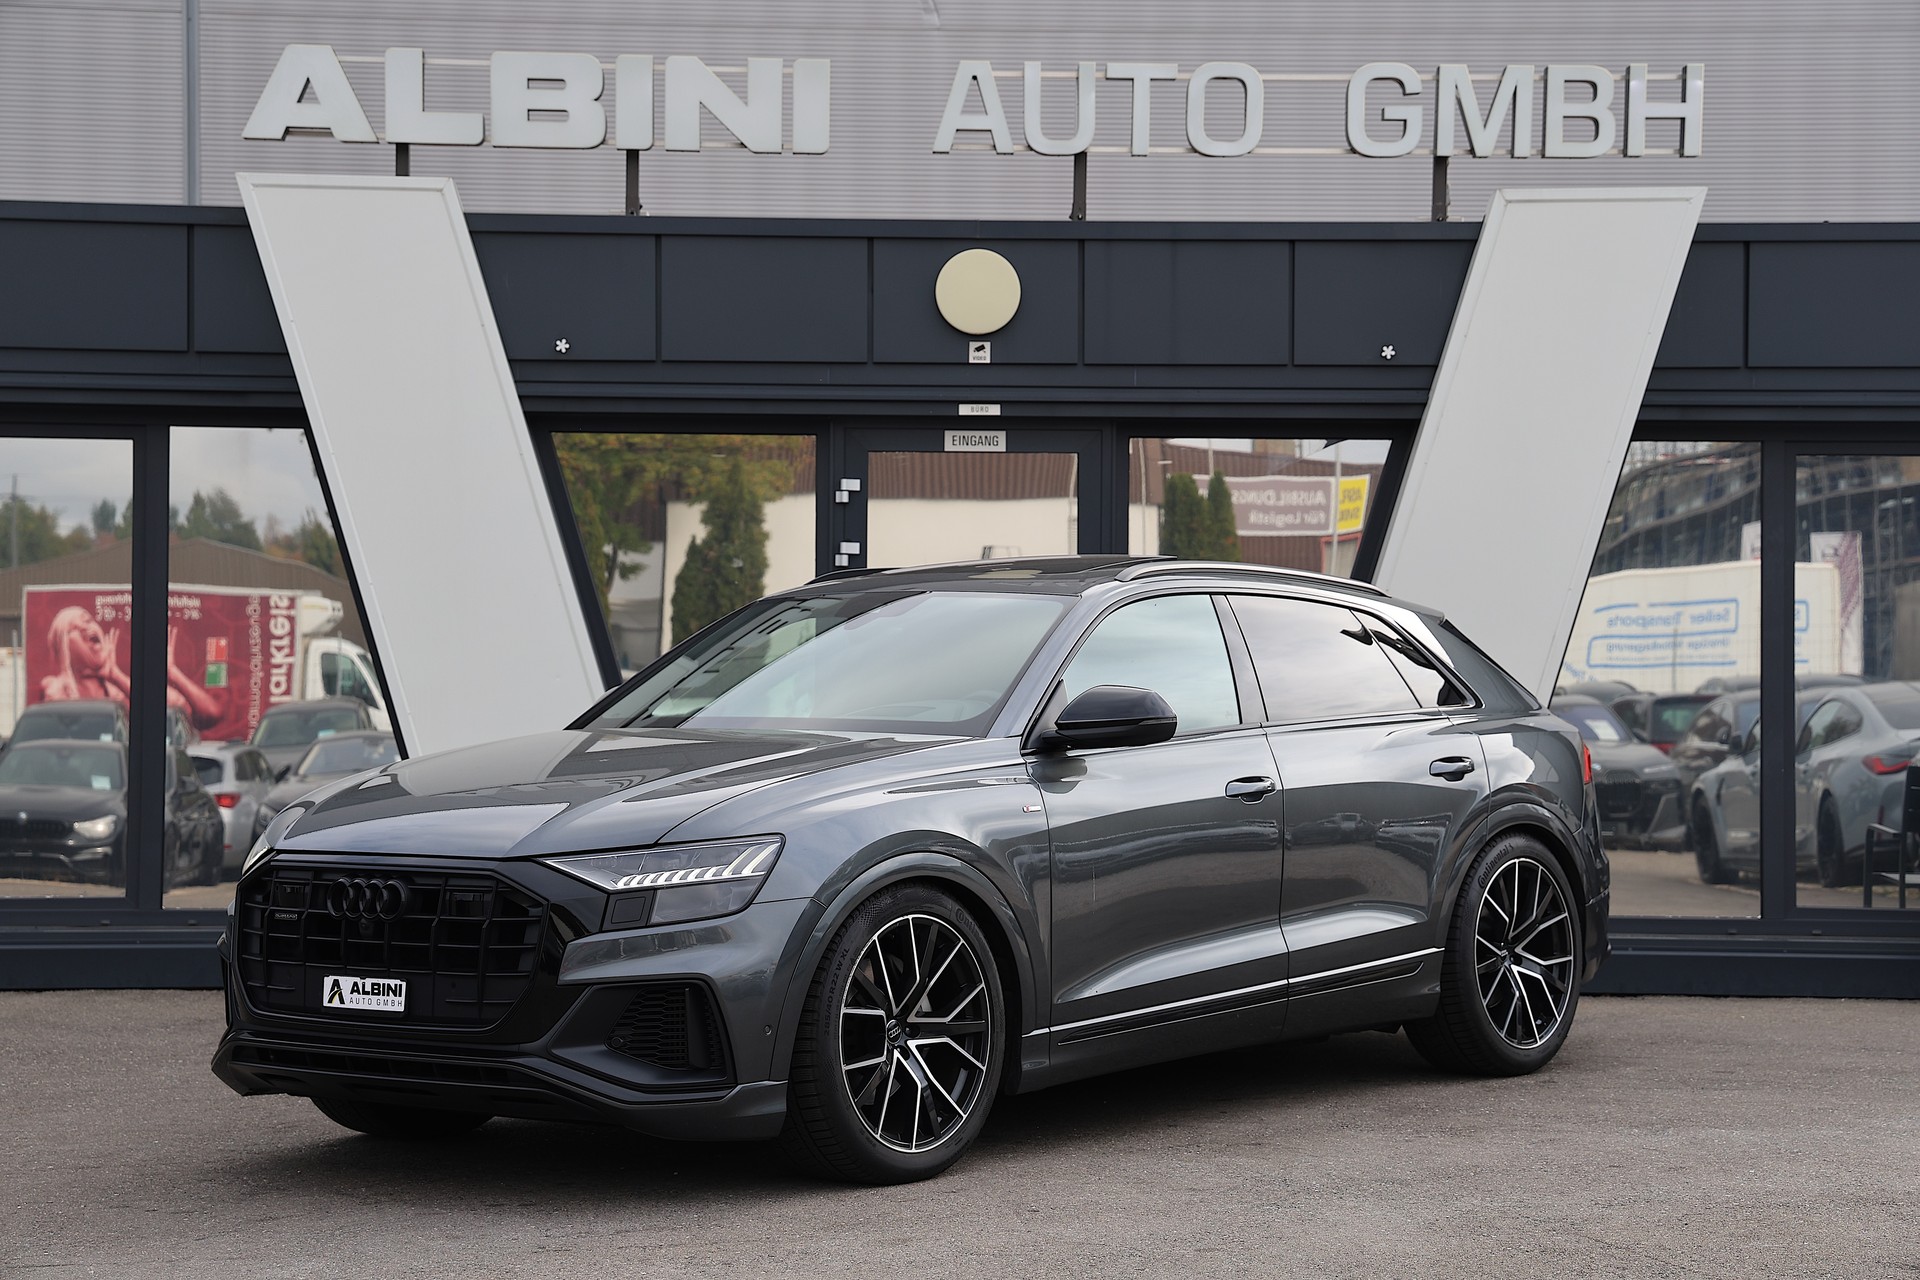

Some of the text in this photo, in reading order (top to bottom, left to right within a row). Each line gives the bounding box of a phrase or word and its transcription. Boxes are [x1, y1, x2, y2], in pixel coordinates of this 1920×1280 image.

[242, 44, 1705, 159] ALBINI AUTO GMBH
[951, 434, 999, 446] EINGANG
[1477, 844, 1510, 889] Continental
[840, 945, 851, 959] XL
[350, 981, 403, 997] ALBINI
[349, 997, 403, 1007] AUTO GMBH
